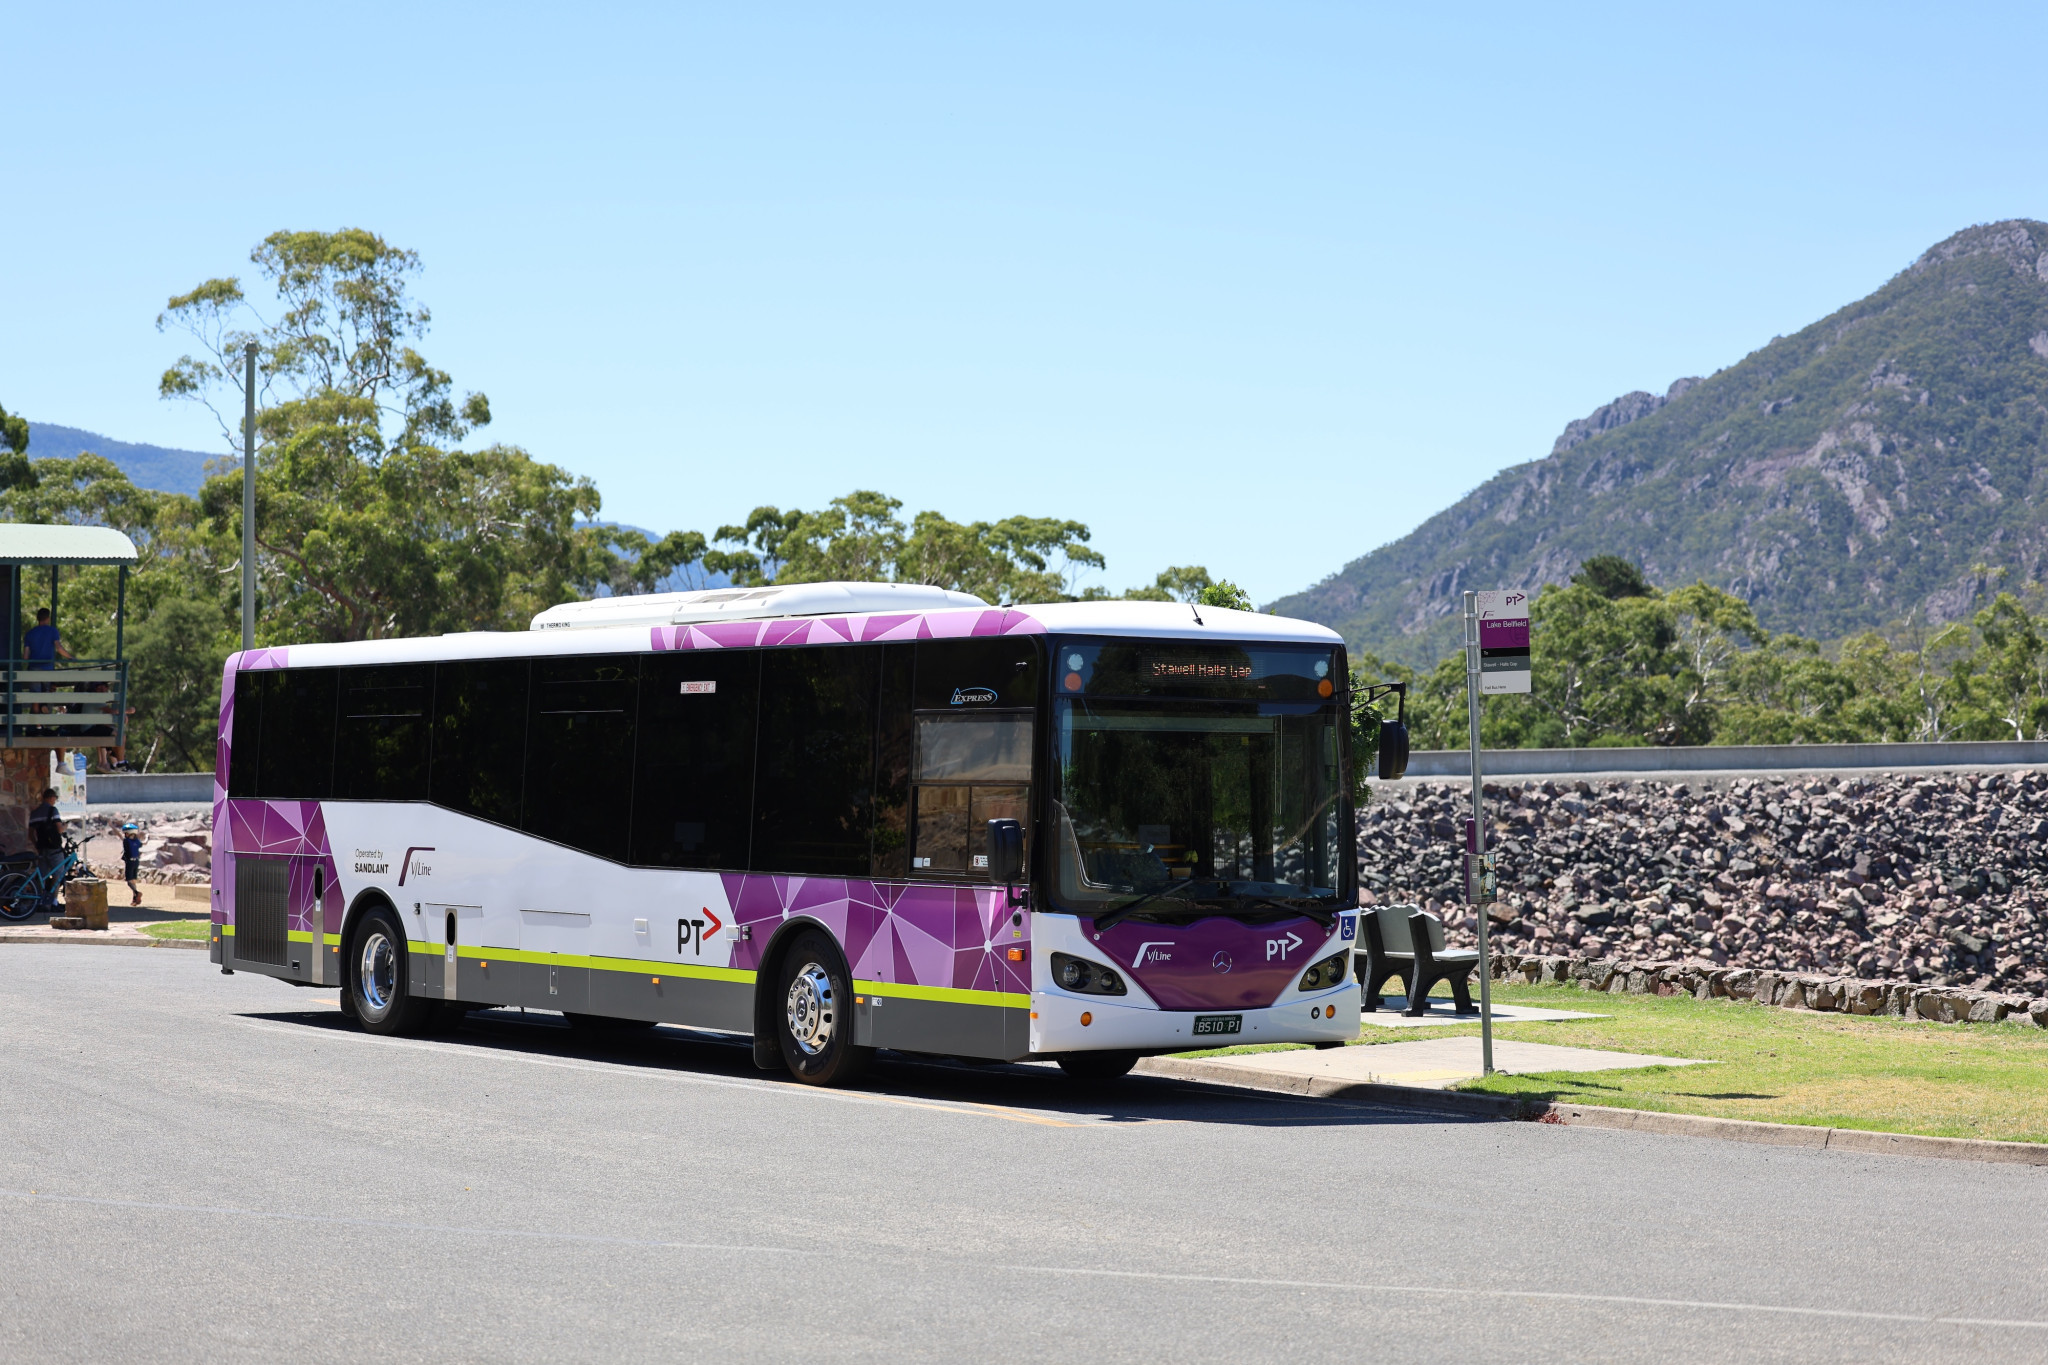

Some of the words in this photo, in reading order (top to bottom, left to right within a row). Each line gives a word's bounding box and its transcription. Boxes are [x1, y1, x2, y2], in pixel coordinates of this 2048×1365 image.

[1505, 596, 1518, 606] PT
[1486, 621, 1502, 629] Lake
[1502, 620, 1527, 628] Bellfield
[1152, 663, 1195, 676] Stawell
[1198, 664, 1227, 677] Halls
[953, 692, 994, 703] EXPRESS
[354, 848, 377, 860] Operated
[377, 849, 384, 861] by
[354, 862, 389, 875] SANDLANT
[410, 858, 432, 881] V/Line
[677, 918, 705, 956] PT
[1147, 948, 1172, 964] V/Line
[1266, 939, 1290, 962] PT
